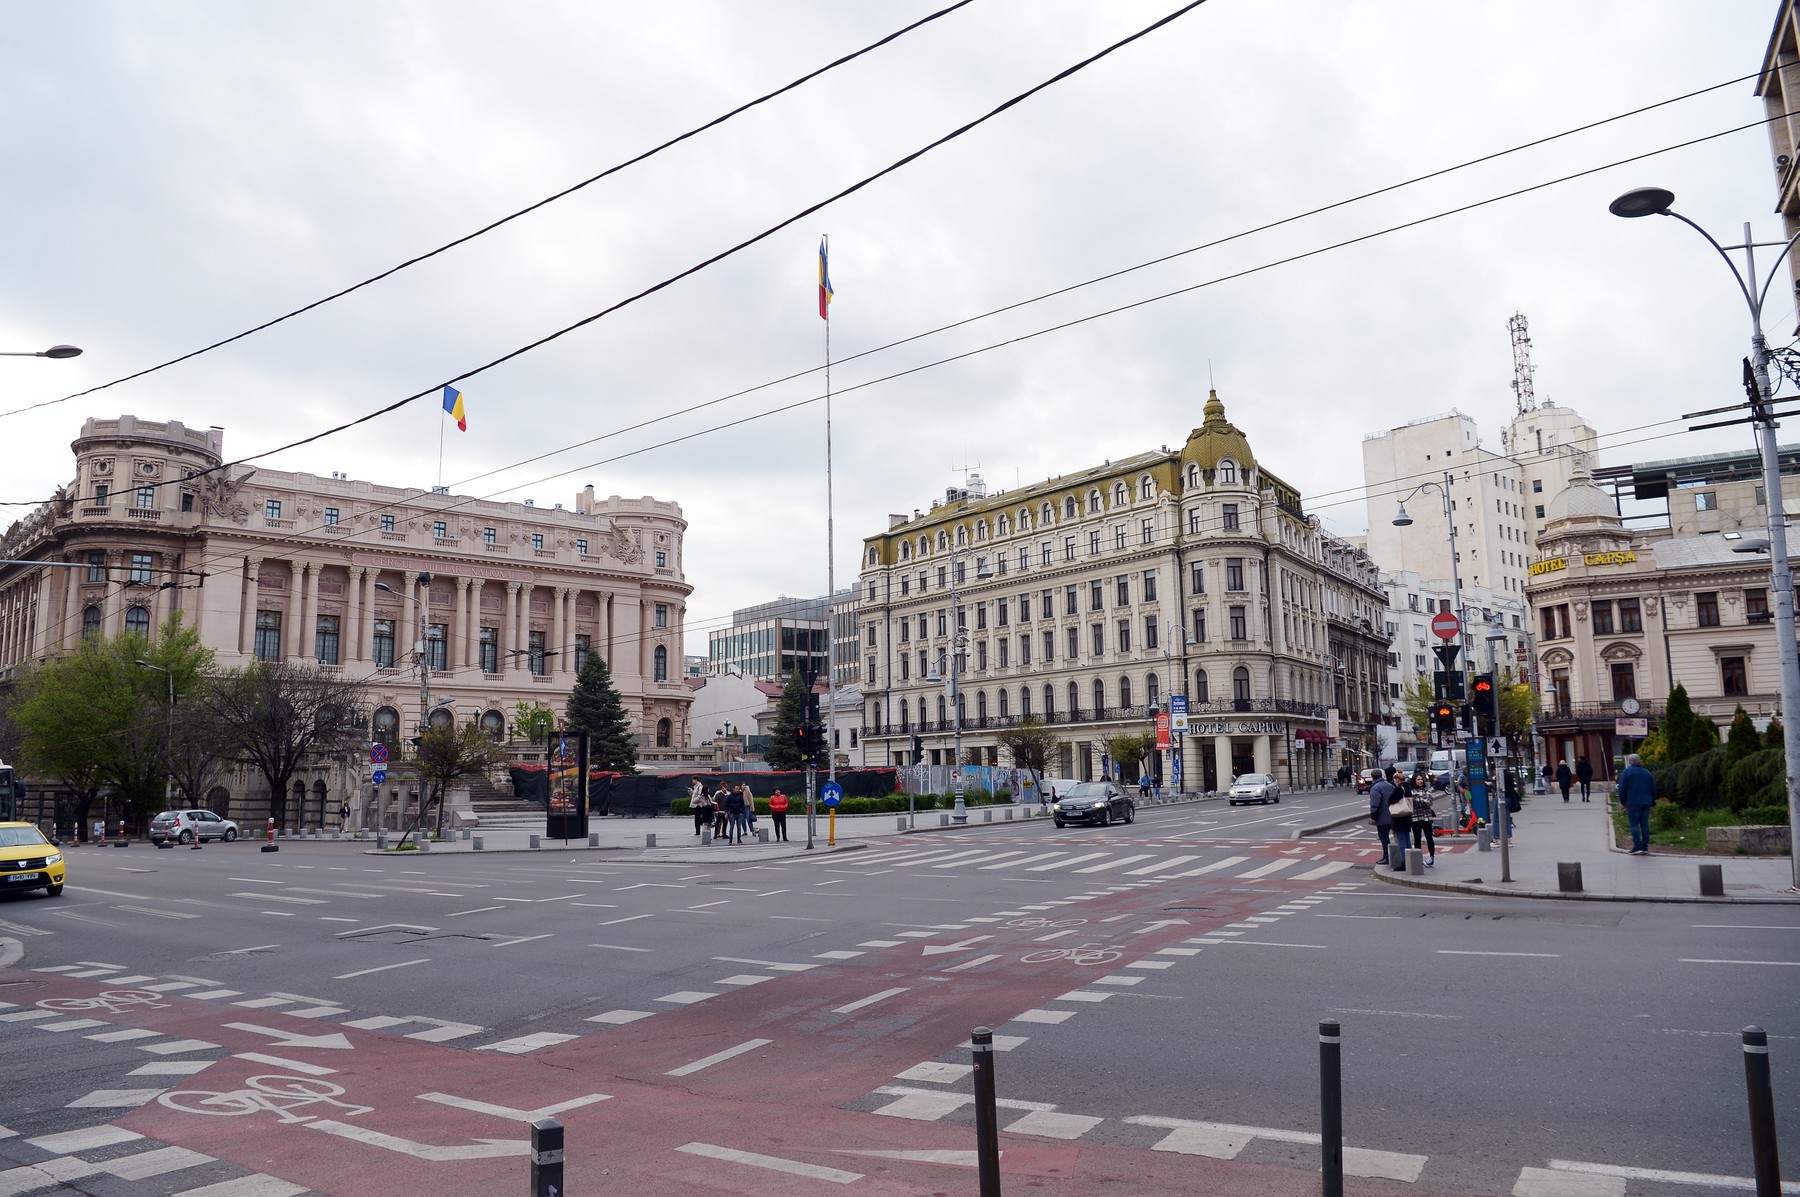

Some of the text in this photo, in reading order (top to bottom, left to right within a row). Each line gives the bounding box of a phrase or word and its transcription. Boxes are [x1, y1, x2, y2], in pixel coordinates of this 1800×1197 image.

[1528, 559, 1567, 576] HOTEL
[1188, 721, 1284, 735] HOTEL CAPITO
